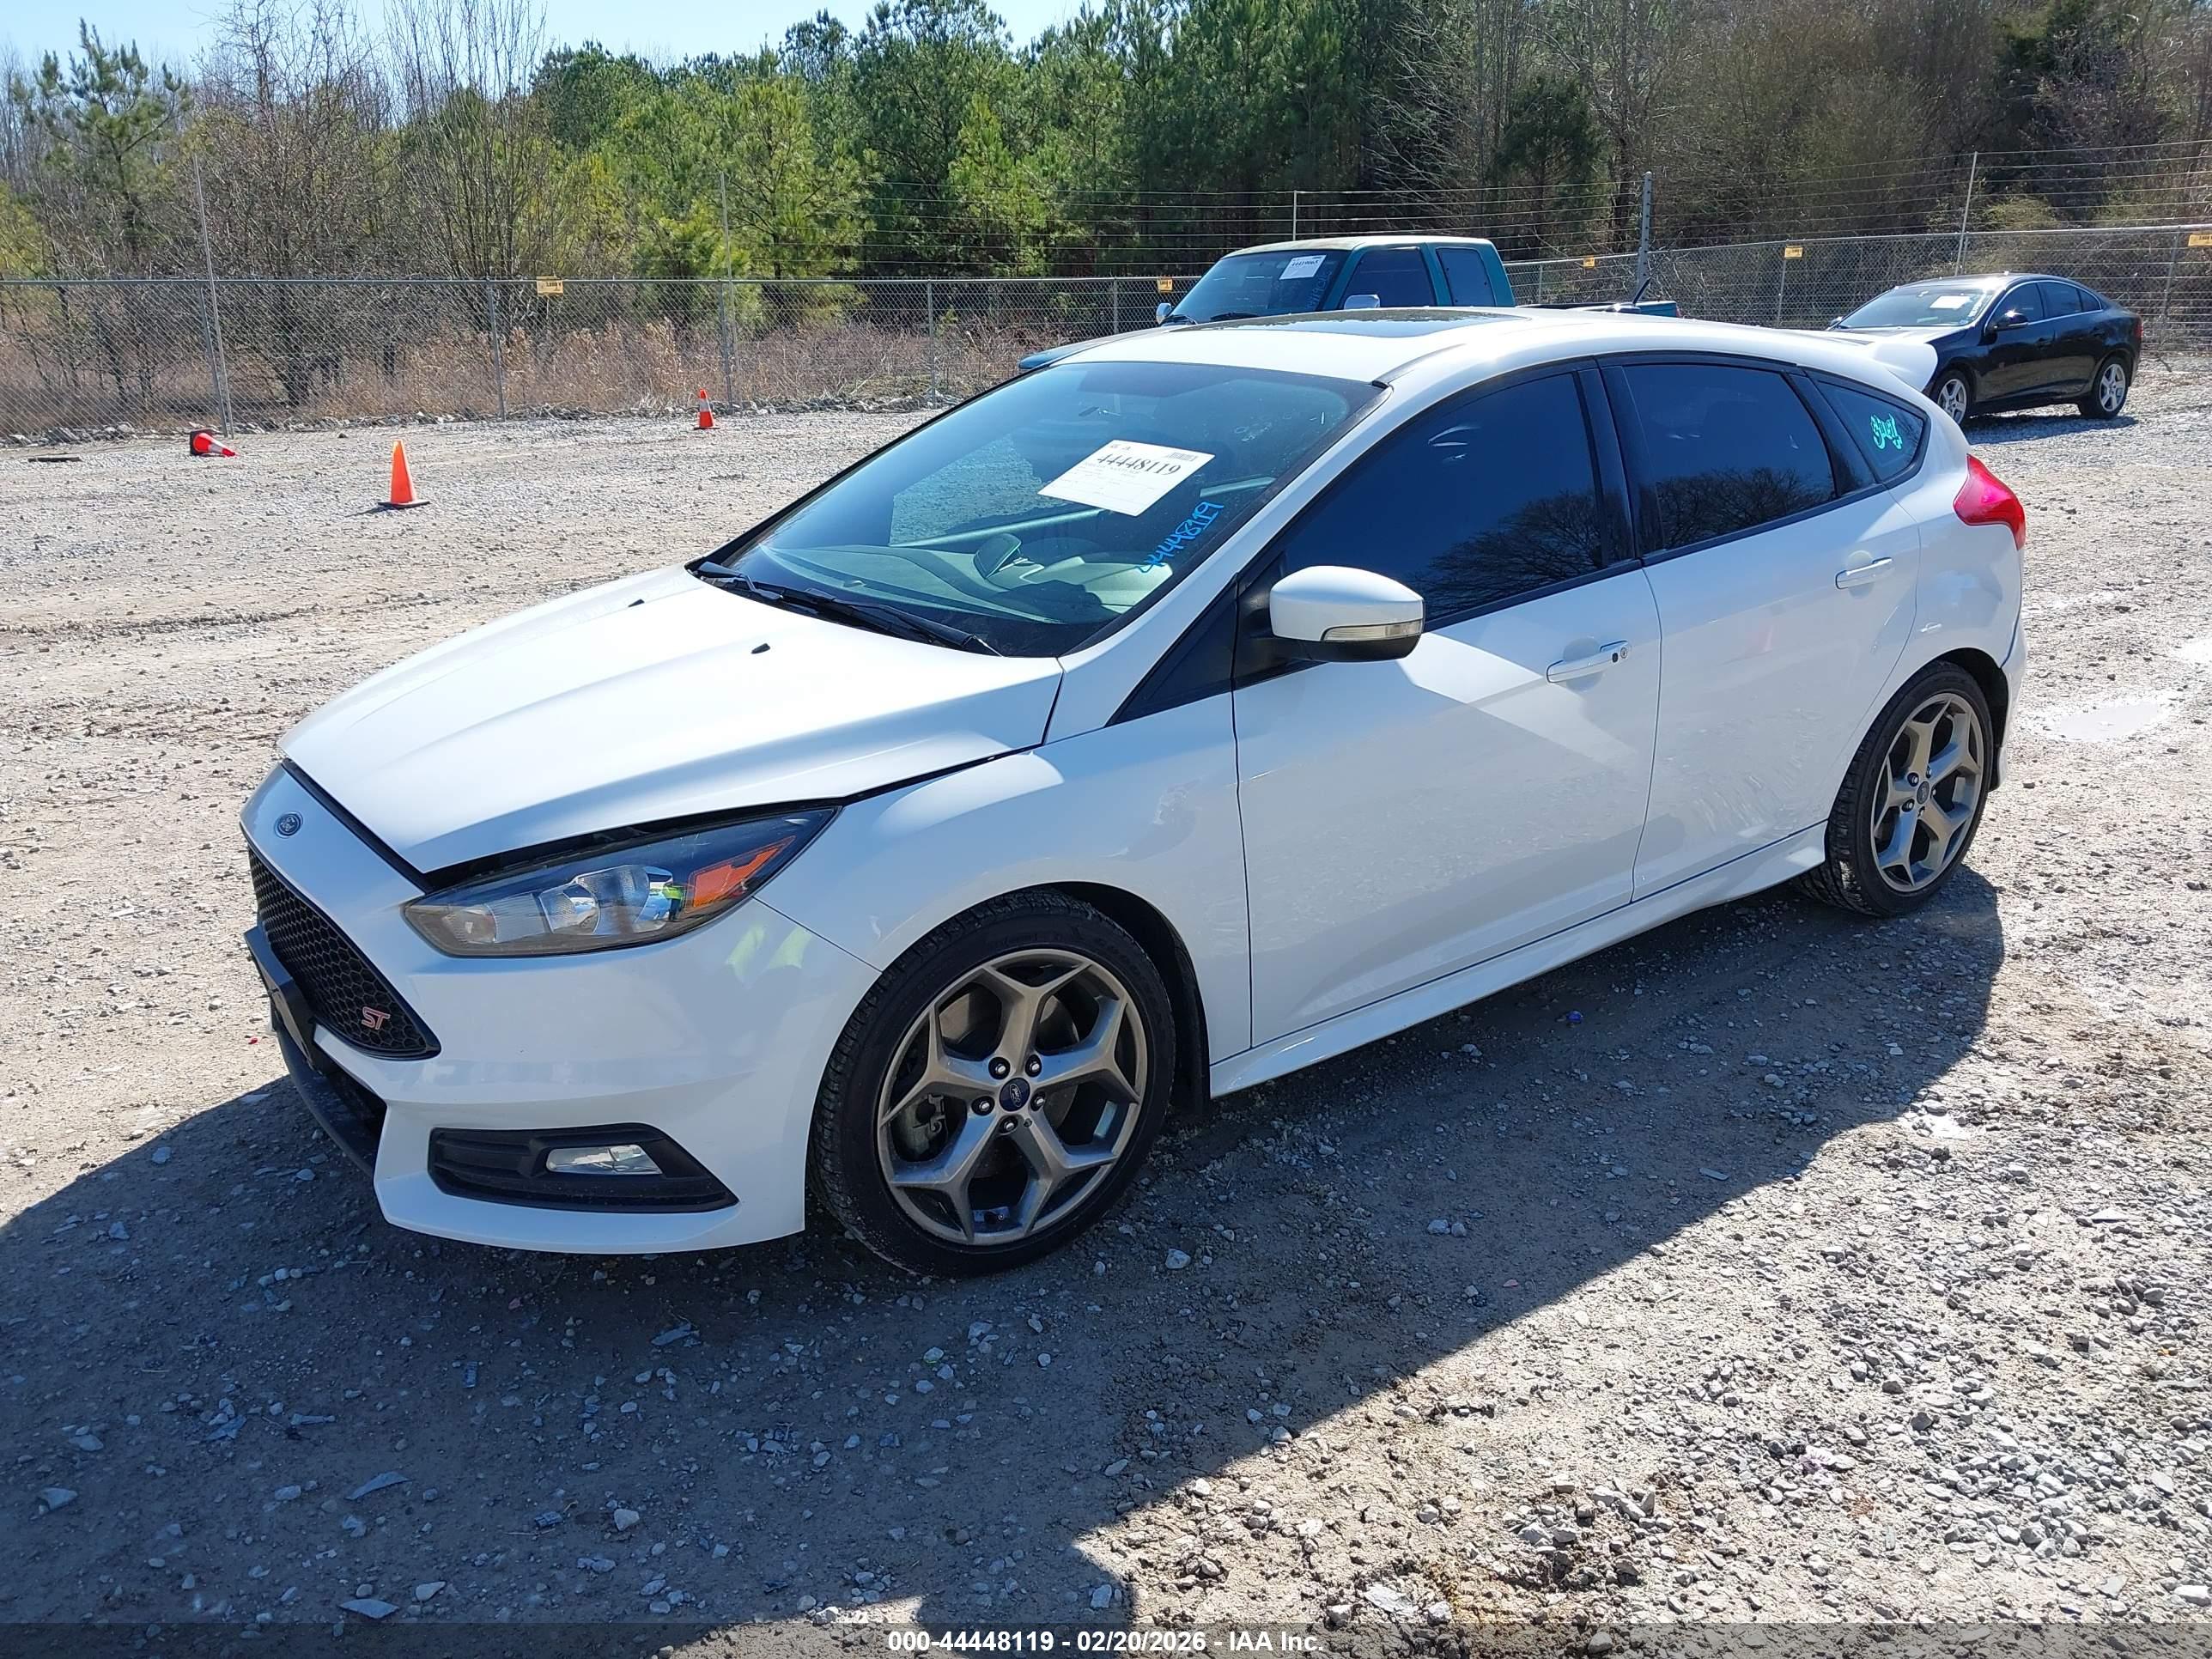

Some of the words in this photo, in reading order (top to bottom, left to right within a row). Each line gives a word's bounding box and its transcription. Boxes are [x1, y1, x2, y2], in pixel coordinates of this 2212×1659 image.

[1097, 453, 1182, 475] 44448119
[1133, 501, 1224, 574] 44448119
[361, 1006, 391, 1030] ST
